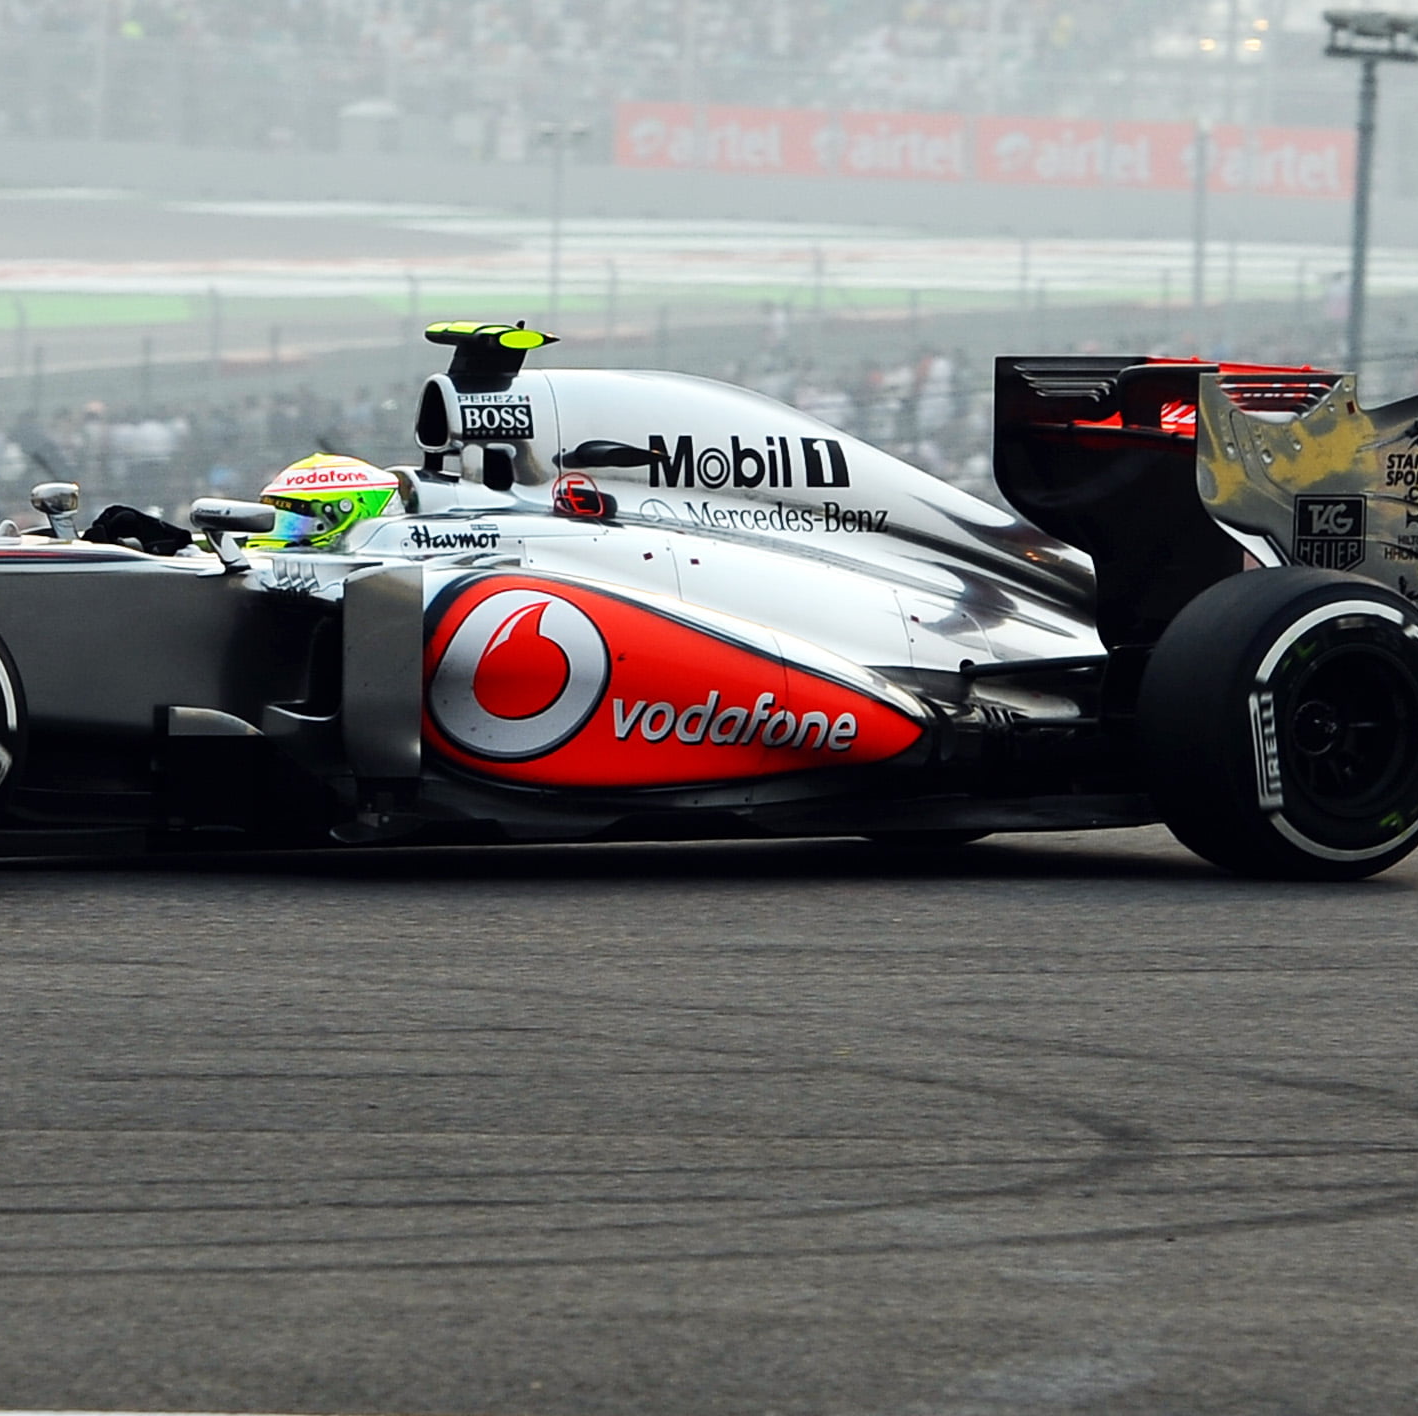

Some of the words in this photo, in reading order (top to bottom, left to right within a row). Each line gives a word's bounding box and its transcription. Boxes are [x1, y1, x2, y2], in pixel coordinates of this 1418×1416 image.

[457, 394, 514, 403] PEREZ
[463, 406, 530, 430] BOSS
[648, 434, 793, 489] Mobil
[809, 438, 839, 485] 1
[285, 470, 369, 486] vodafone
[683, 501, 889, 534] Mercedes-Benz
[1307, 502, 1355, 535] TAG
[408, 525, 501, 549] Havmor
[1299, 541, 1360, 570] HEUER
[612, 689, 858, 751] vodafone
